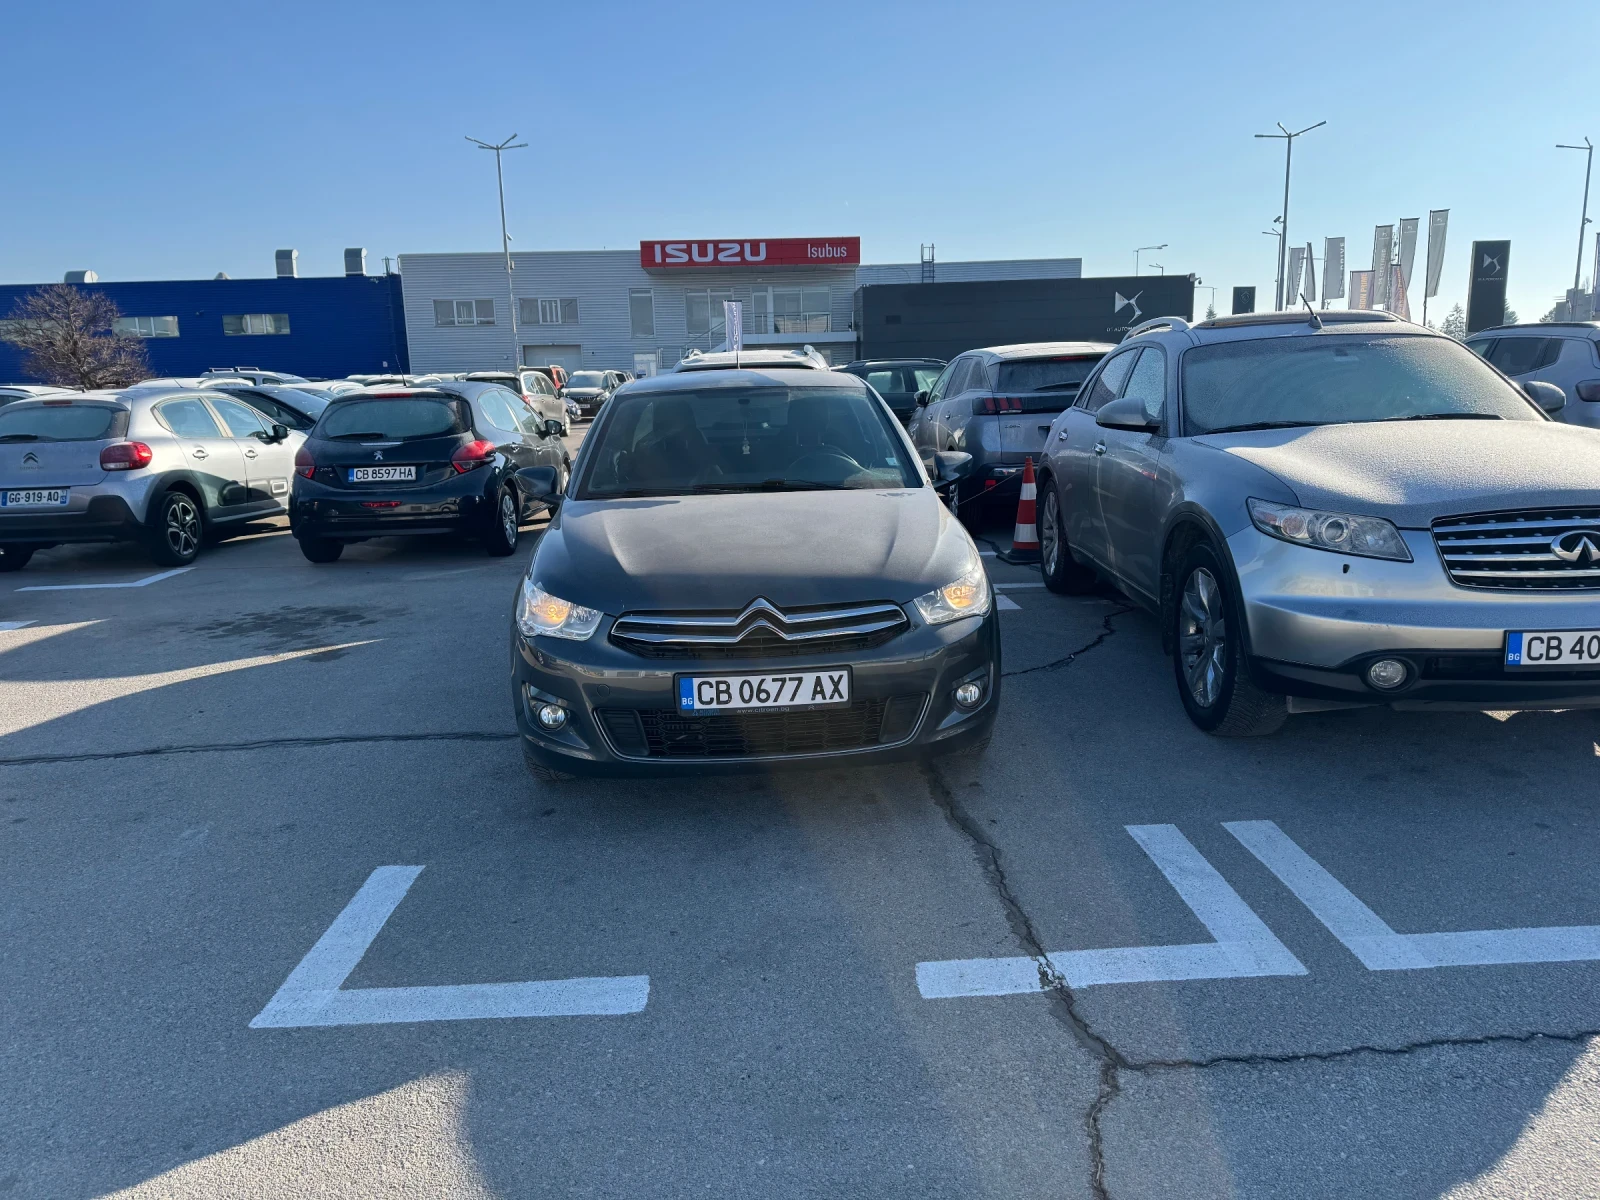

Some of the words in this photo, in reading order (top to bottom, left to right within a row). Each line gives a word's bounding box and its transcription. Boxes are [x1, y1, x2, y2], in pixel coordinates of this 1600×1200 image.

[654, 242, 767, 263] ISUZU
[807, 243, 847, 258] Isubus
[1360, 273, 1368, 293] PRIME
[355, 469, 369, 480] CB
[371, 468, 397, 479] 8597
[399, 467, 413, 478] HA
[1508, 653, 1520, 661] BG
[1526, 636, 1563, 661] CB
[1569, 635, 1600, 660] 40
[681, 697, 693, 705] BG
[697, 680, 733, 706] CB
[738, 676, 804, 704] 0677
[811, 674, 845, 701] AX
[736, 706, 790, 714] www.citroen.bg
